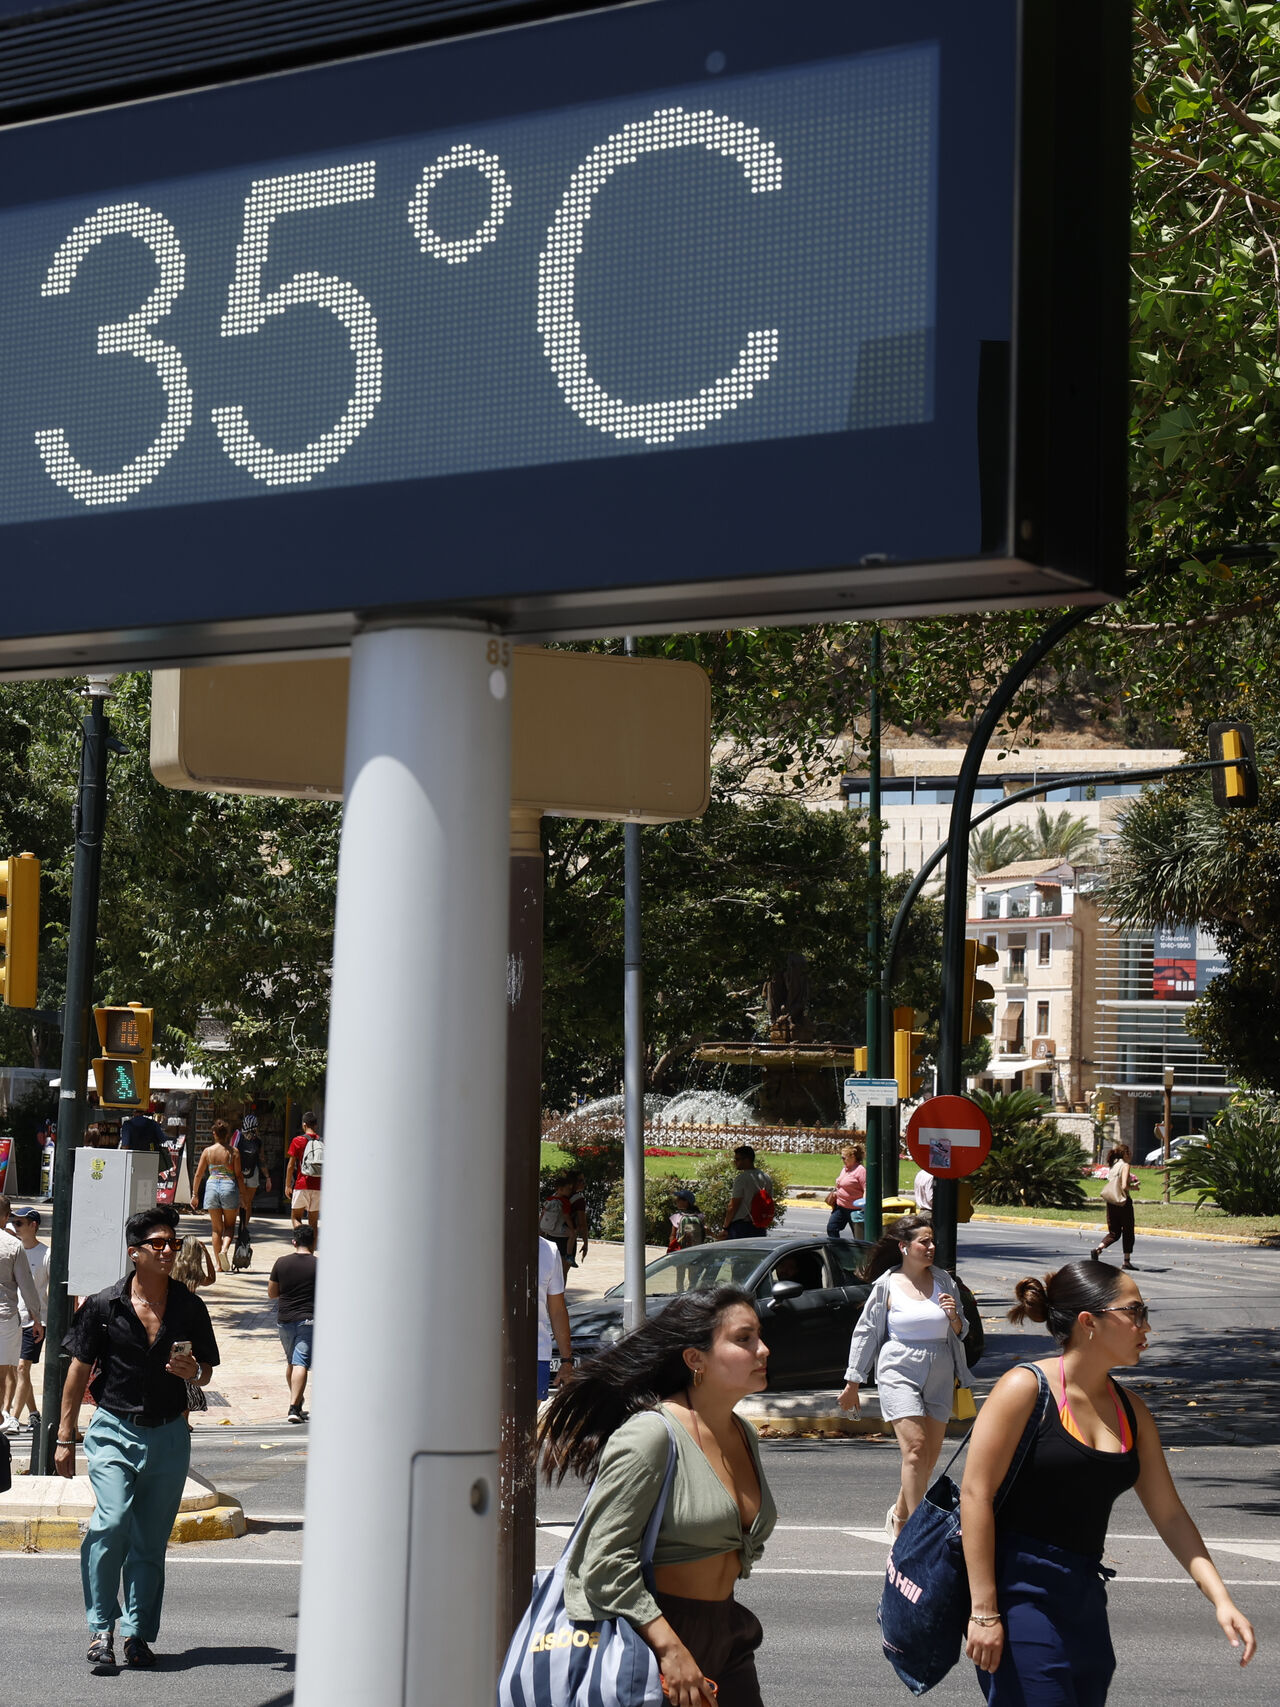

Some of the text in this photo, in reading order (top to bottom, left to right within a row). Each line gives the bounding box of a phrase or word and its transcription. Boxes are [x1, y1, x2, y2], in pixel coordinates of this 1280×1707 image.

[34, 107, 783, 506] 35°C
[120, 1020, 139, 1046] 10
[895, 1570, 923, 1604] Hill
